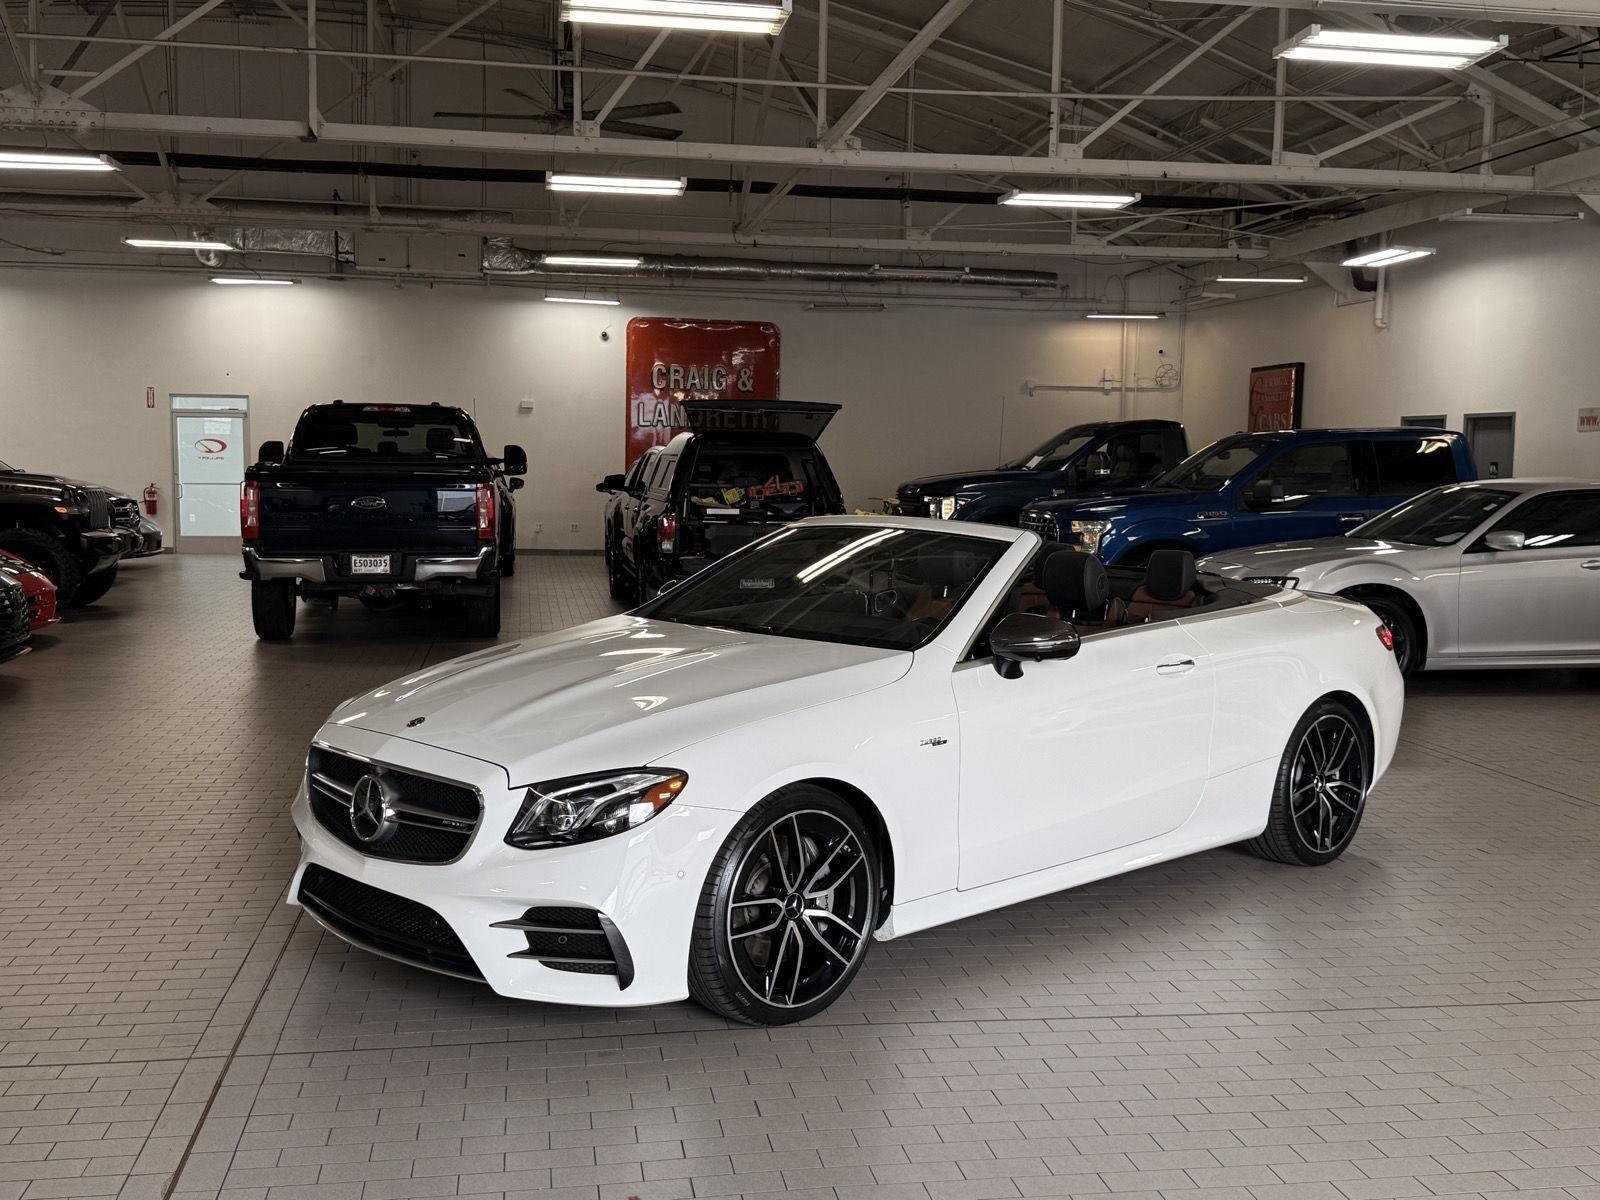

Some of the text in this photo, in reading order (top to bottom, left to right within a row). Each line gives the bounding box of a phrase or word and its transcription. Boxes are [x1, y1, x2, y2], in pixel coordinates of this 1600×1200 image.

[652, 363, 754, 392] CRAIG &
[353, 559, 388, 568] E503035
